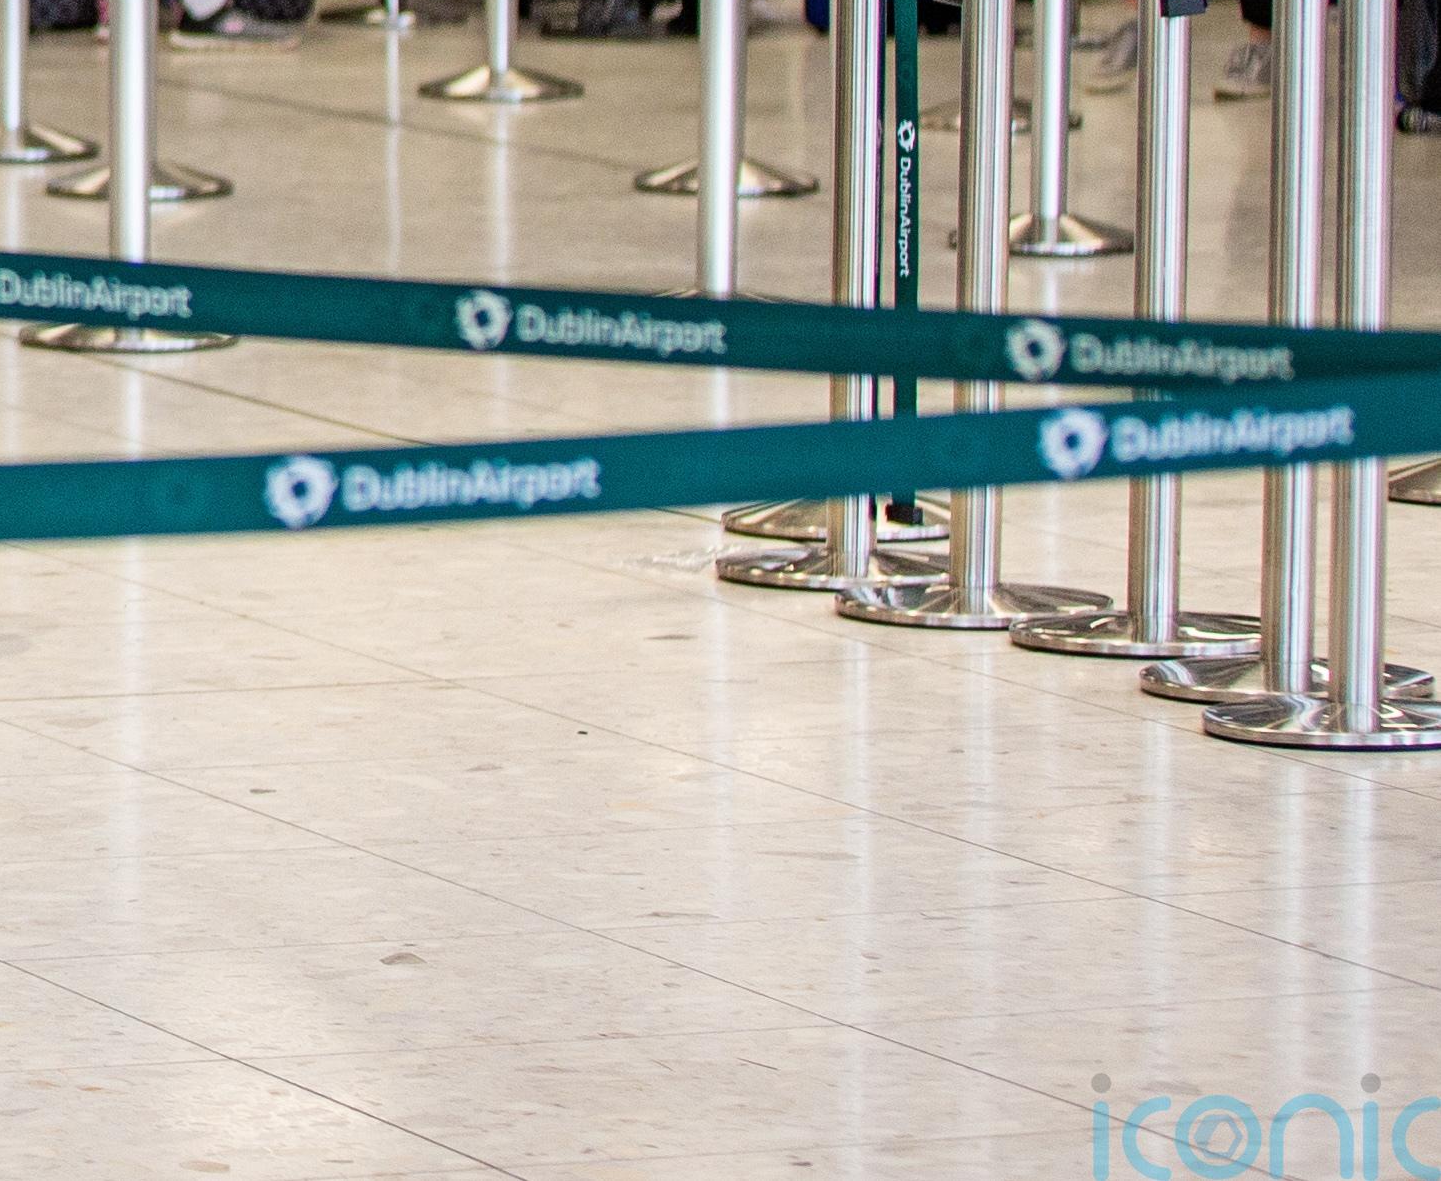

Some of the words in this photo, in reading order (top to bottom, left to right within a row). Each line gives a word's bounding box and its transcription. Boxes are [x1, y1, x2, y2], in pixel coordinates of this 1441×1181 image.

[898, 156, 912, 279] DublinAirport
[517, 303, 728, 357] DublinAirport
[341, 456, 602, 511] DublinAirport
